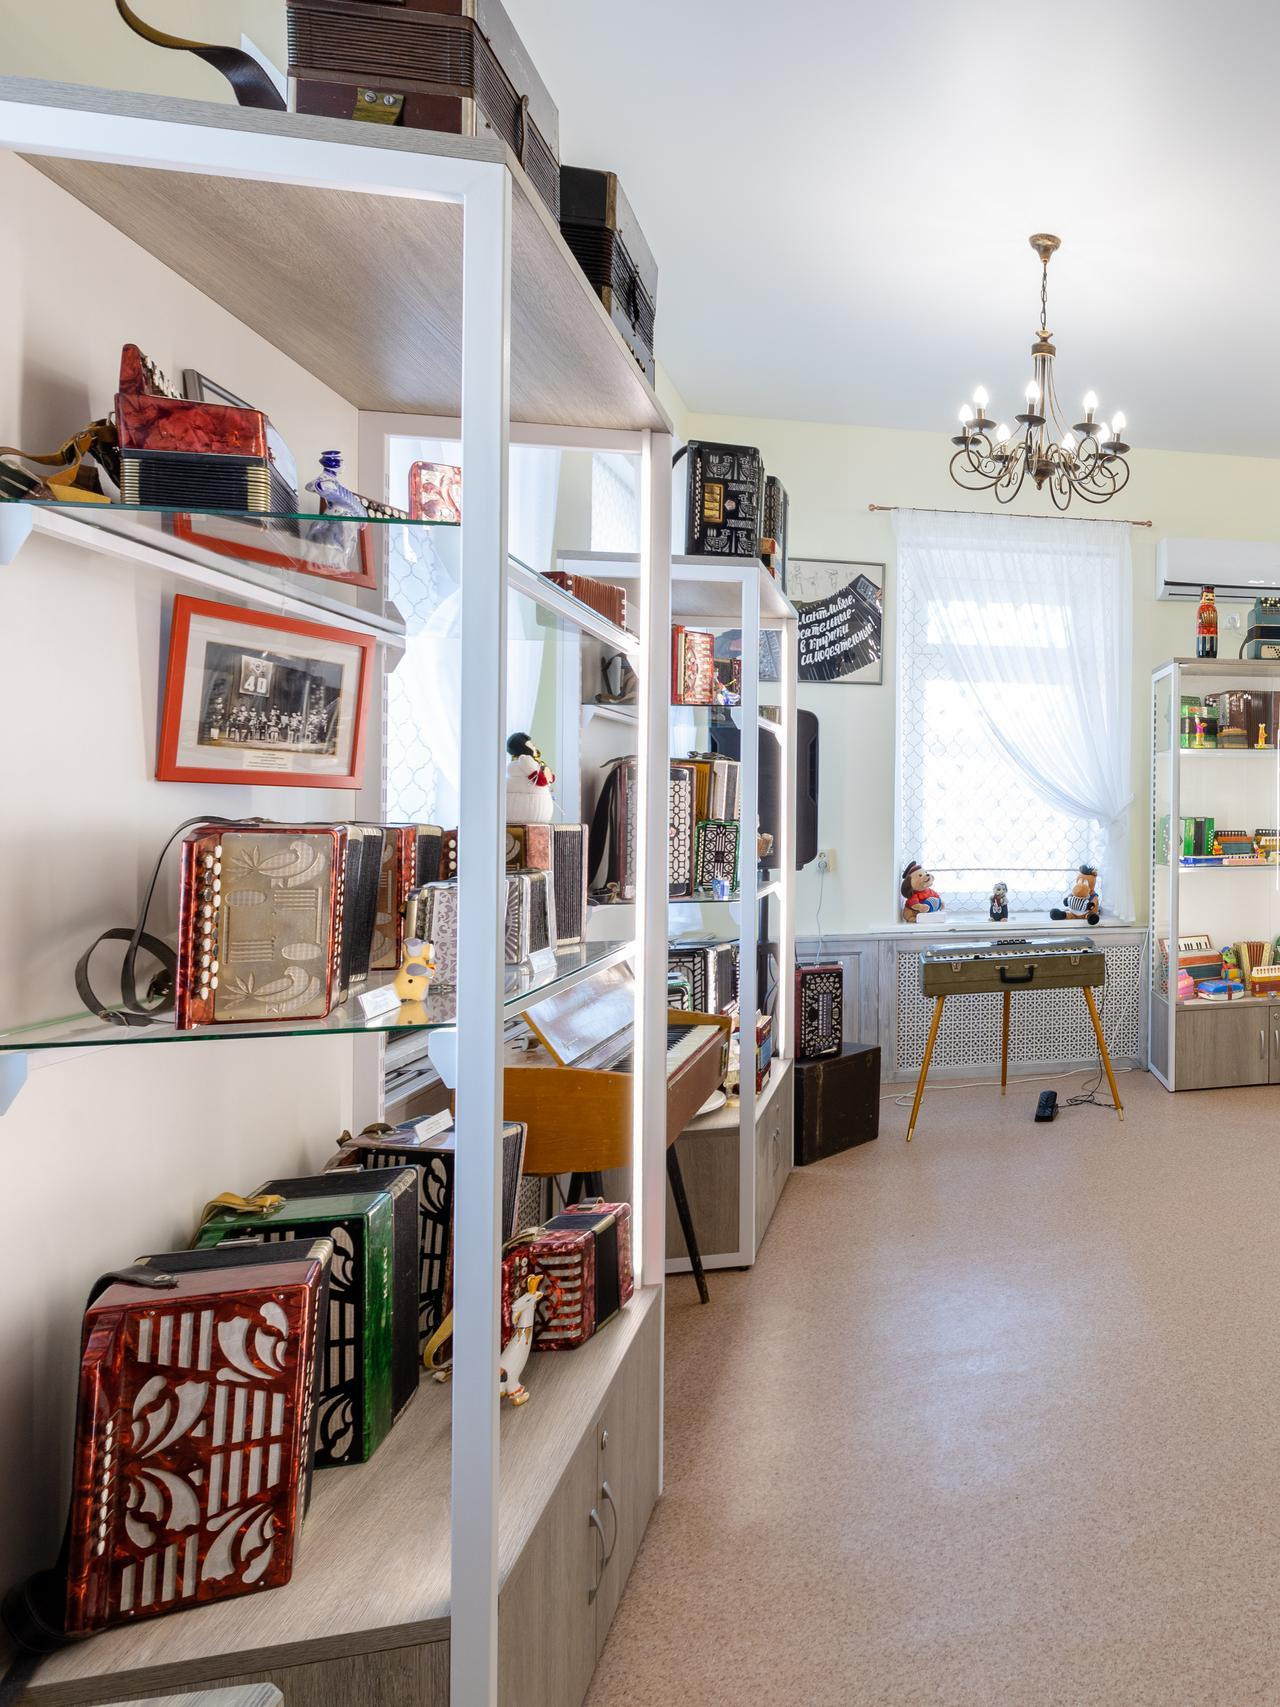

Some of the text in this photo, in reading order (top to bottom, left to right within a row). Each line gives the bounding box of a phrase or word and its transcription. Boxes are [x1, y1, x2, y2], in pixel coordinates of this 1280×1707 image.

[799, 595, 856, 625] лантливые,
[800, 640, 807, 653] в
[801, 615, 877, 665] самодеятельные!
[243, 675, 267, 694] 40
